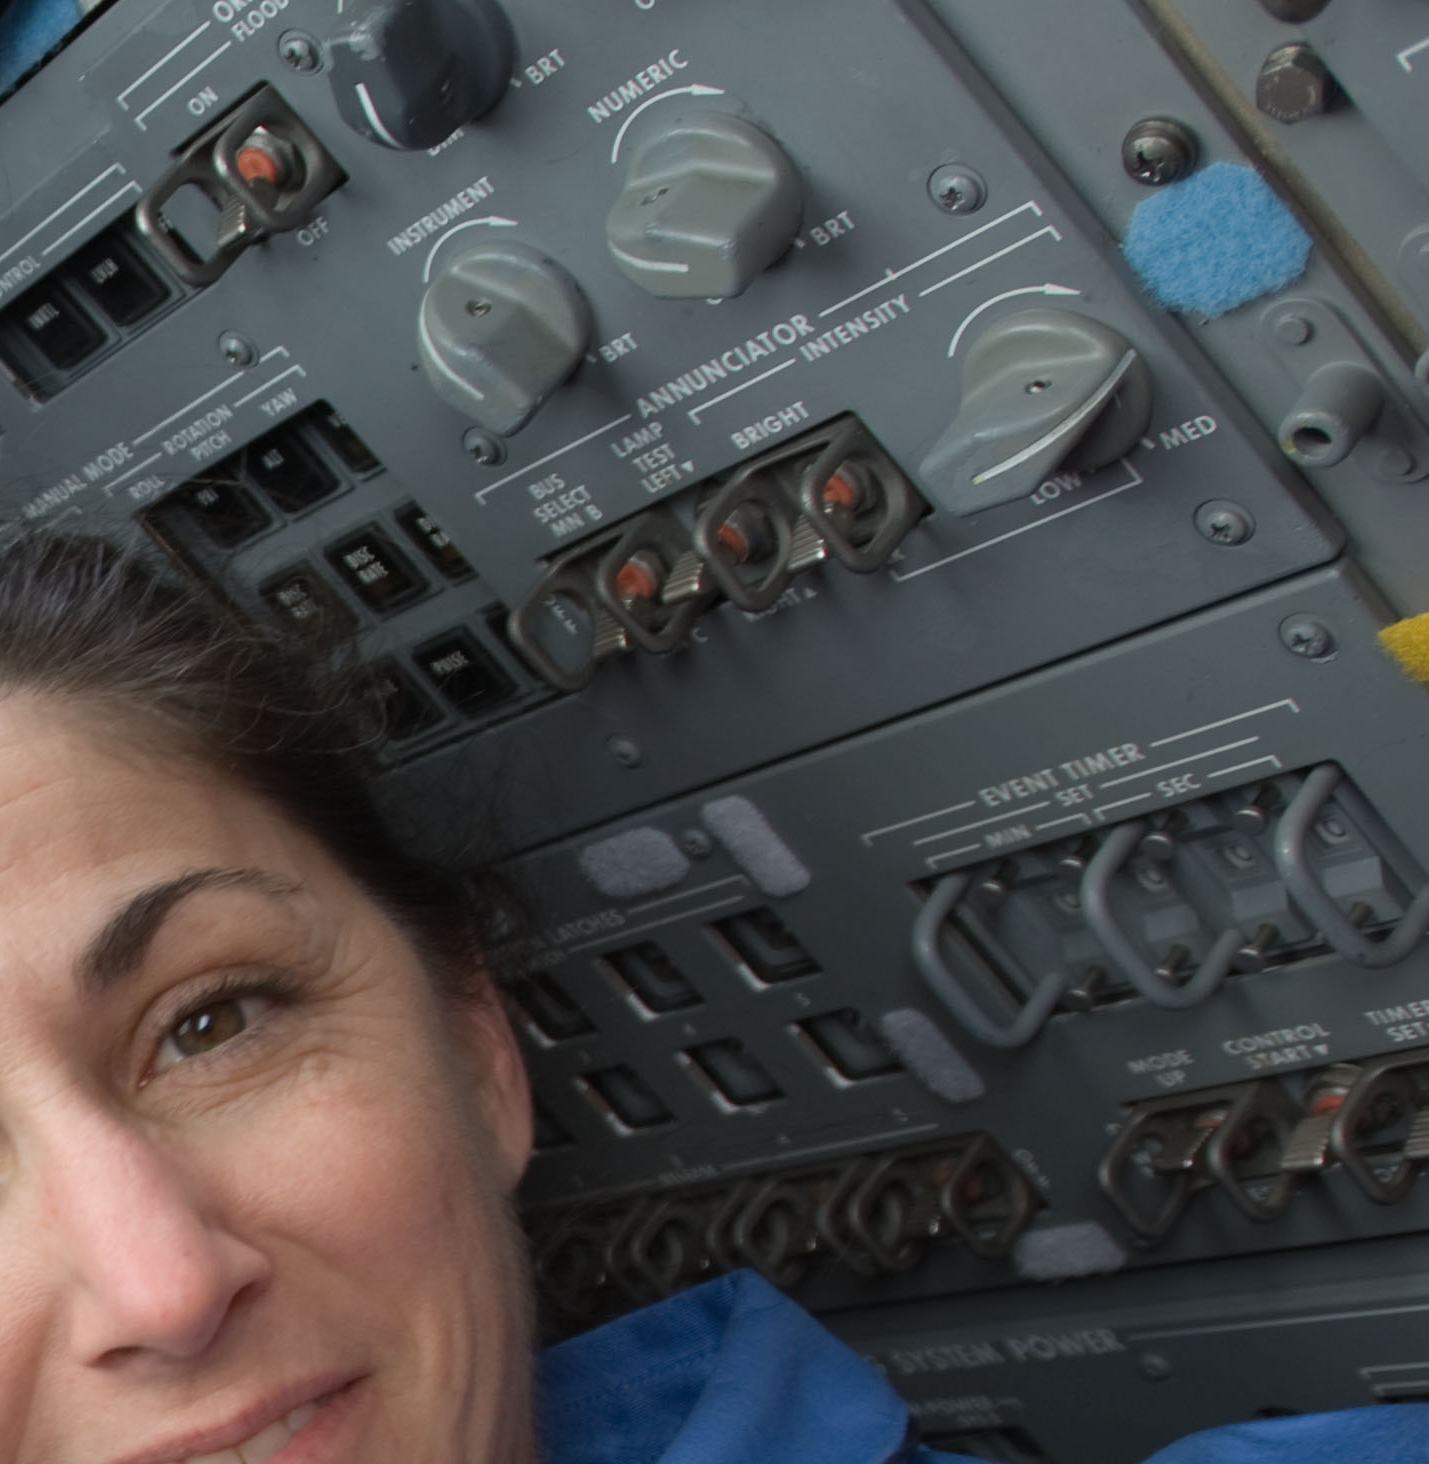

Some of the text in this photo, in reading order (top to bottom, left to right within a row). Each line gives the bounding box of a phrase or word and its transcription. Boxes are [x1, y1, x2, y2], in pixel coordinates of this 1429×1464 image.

[525, 49, 566, 87] BRT
[188, 86, 218, 116] ON
[588, 49, 689, 124] NUMERIC
[296, 217, 331, 248] OFF
[386, 176, 496, 257] INSTRUMENT
[808, 210, 857, 248] BRT
[799, 294, 911, 363] INTENSITY
[599, 333, 639, 364] BRT
[636, 314, 816, 420] ANNUNCIATOR
[259, 387, 298, 417] YAW
[162, 403, 234, 457] ROTATION
[610, 421, 664, 459] LAMP
[730, 400, 810, 451] BRIGHT
[1159, 415, 1217, 452] MED
[82, 441, 134, 482] MODE
[191, 430, 231, 462] PITCH
[631, 442, 676, 475] TEST
[527, 472, 566, 501] BUS
[641, 465, 683, 495] LEFT
[1029, 470, 1083, 507] LOW
[534, 484, 593, 525] SELECT
[550, 502, 604, 538] MN B
[979, 742, 1147, 809] EVENT TIMER
[984, 773, 1202, 852] MIN SEC
[1055, 783, 1095, 808] SET
[1364, 999, 1429, 1027] TIMER
[1222, 1022, 1332, 1056] CONTROL
[1386, 1019, 1427, 1043] SET
[1127, 1049, 1195, 1076] MODE
[1245, 1043, 1313, 1071] START
[1154, 1069, 1188, 1089] UP
[1011, 1328, 1128, 1362] POWER
